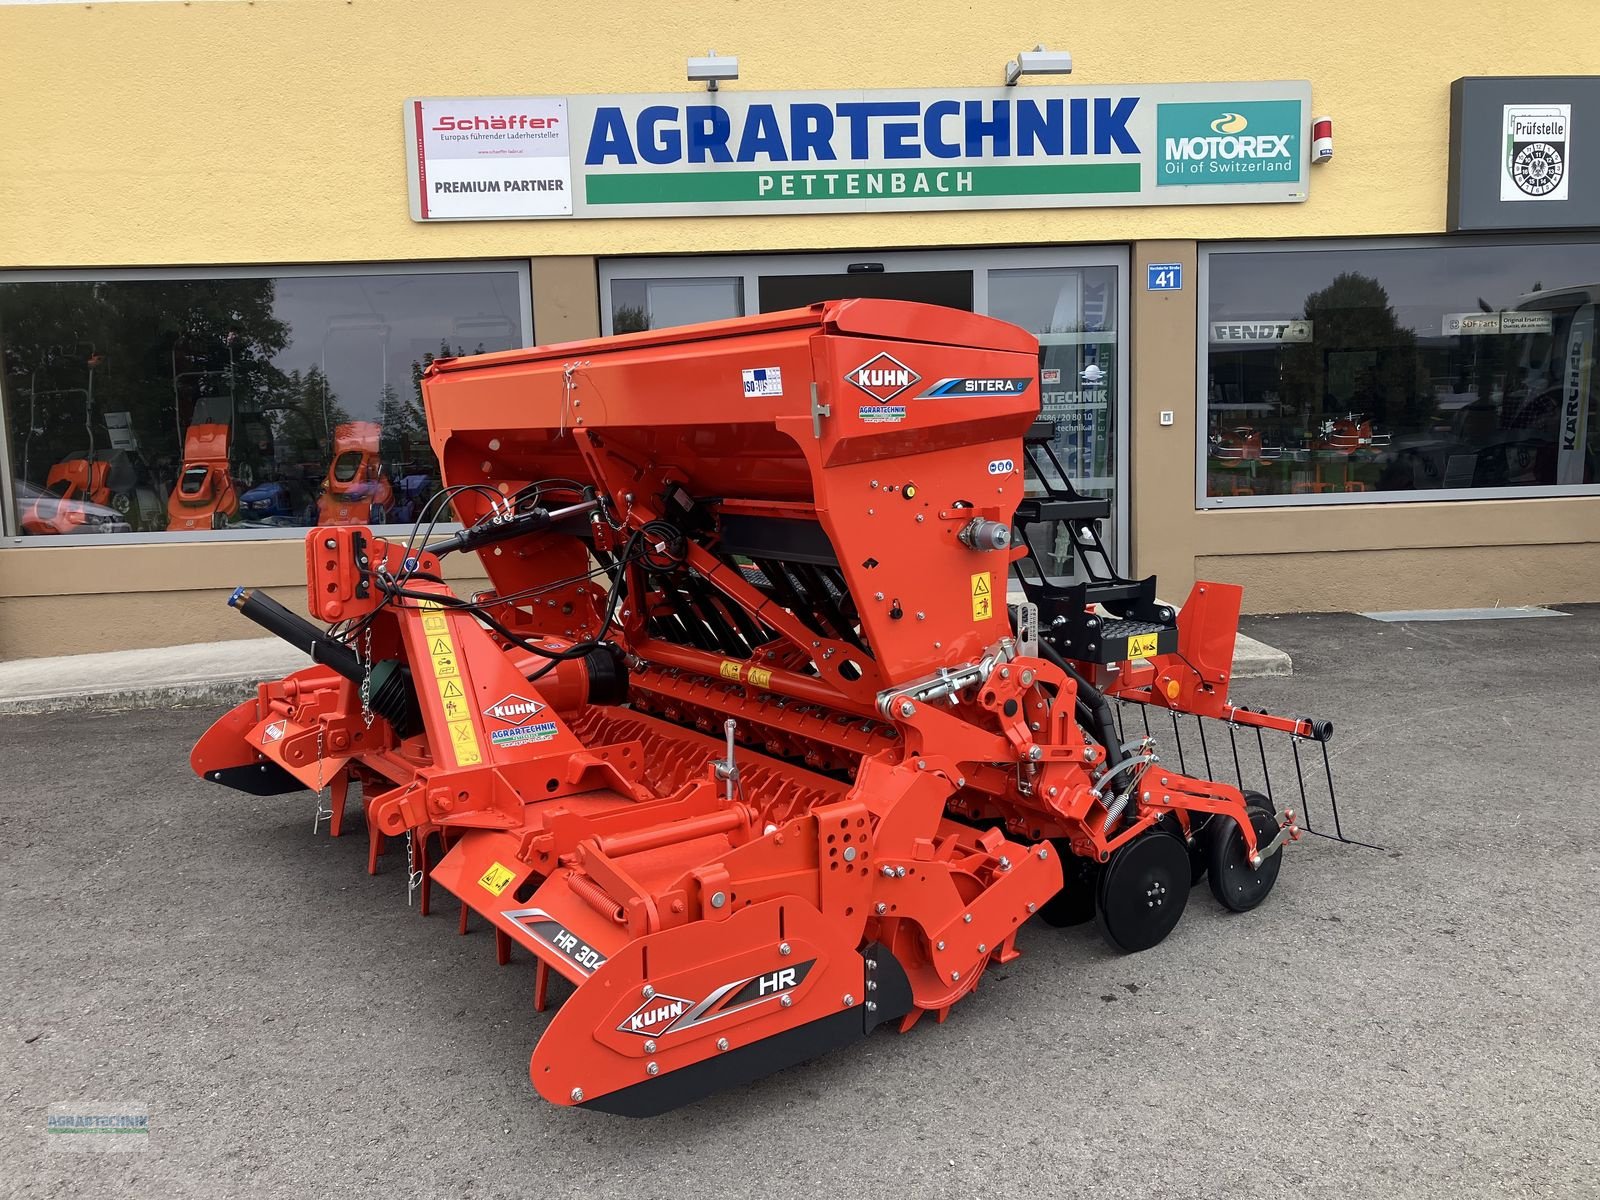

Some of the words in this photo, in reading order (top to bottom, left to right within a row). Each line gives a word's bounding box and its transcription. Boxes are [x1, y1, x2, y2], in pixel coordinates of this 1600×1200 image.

[432, 115, 559, 131] Schäffer
[584, 97, 1140, 165] AGRARTECHNIK
[1516, 122, 1563, 135] Prüfstelle
[440, 133, 469, 142] Europas
[470, 132, 506, 140] führender
[507, 131, 559, 140] Laderhersteller
[1165, 135, 1291, 160] MOTOREX
[1165, 161, 1184, 174] Oil
[1190, 161, 1204, 173] of
[1209, 159, 1292, 173] Switzerland
[435, 181, 500, 193] PREMIUM
[504, 179, 564, 192] PARTNER
[758, 171, 974, 197] PETTENBACH
[1155, 271, 1174, 287] 41
[1214, 325, 1289, 339] FENDT
[858, 369, 909, 386] KUHN
[965, 380, 1014, 391] SITERA
[1042, 390, 1107, 403] RTECHNIK
[1056, 423, 1095, 432] -technik.at
[494, 703, 536, 717] KUHN
[492, 722, 556, 738] AGRARTECHNIK
[553, 929, 578, 954] HR
[758, 967, 797, 996] HR
[631, 1001, 683, 1031] KUHN
